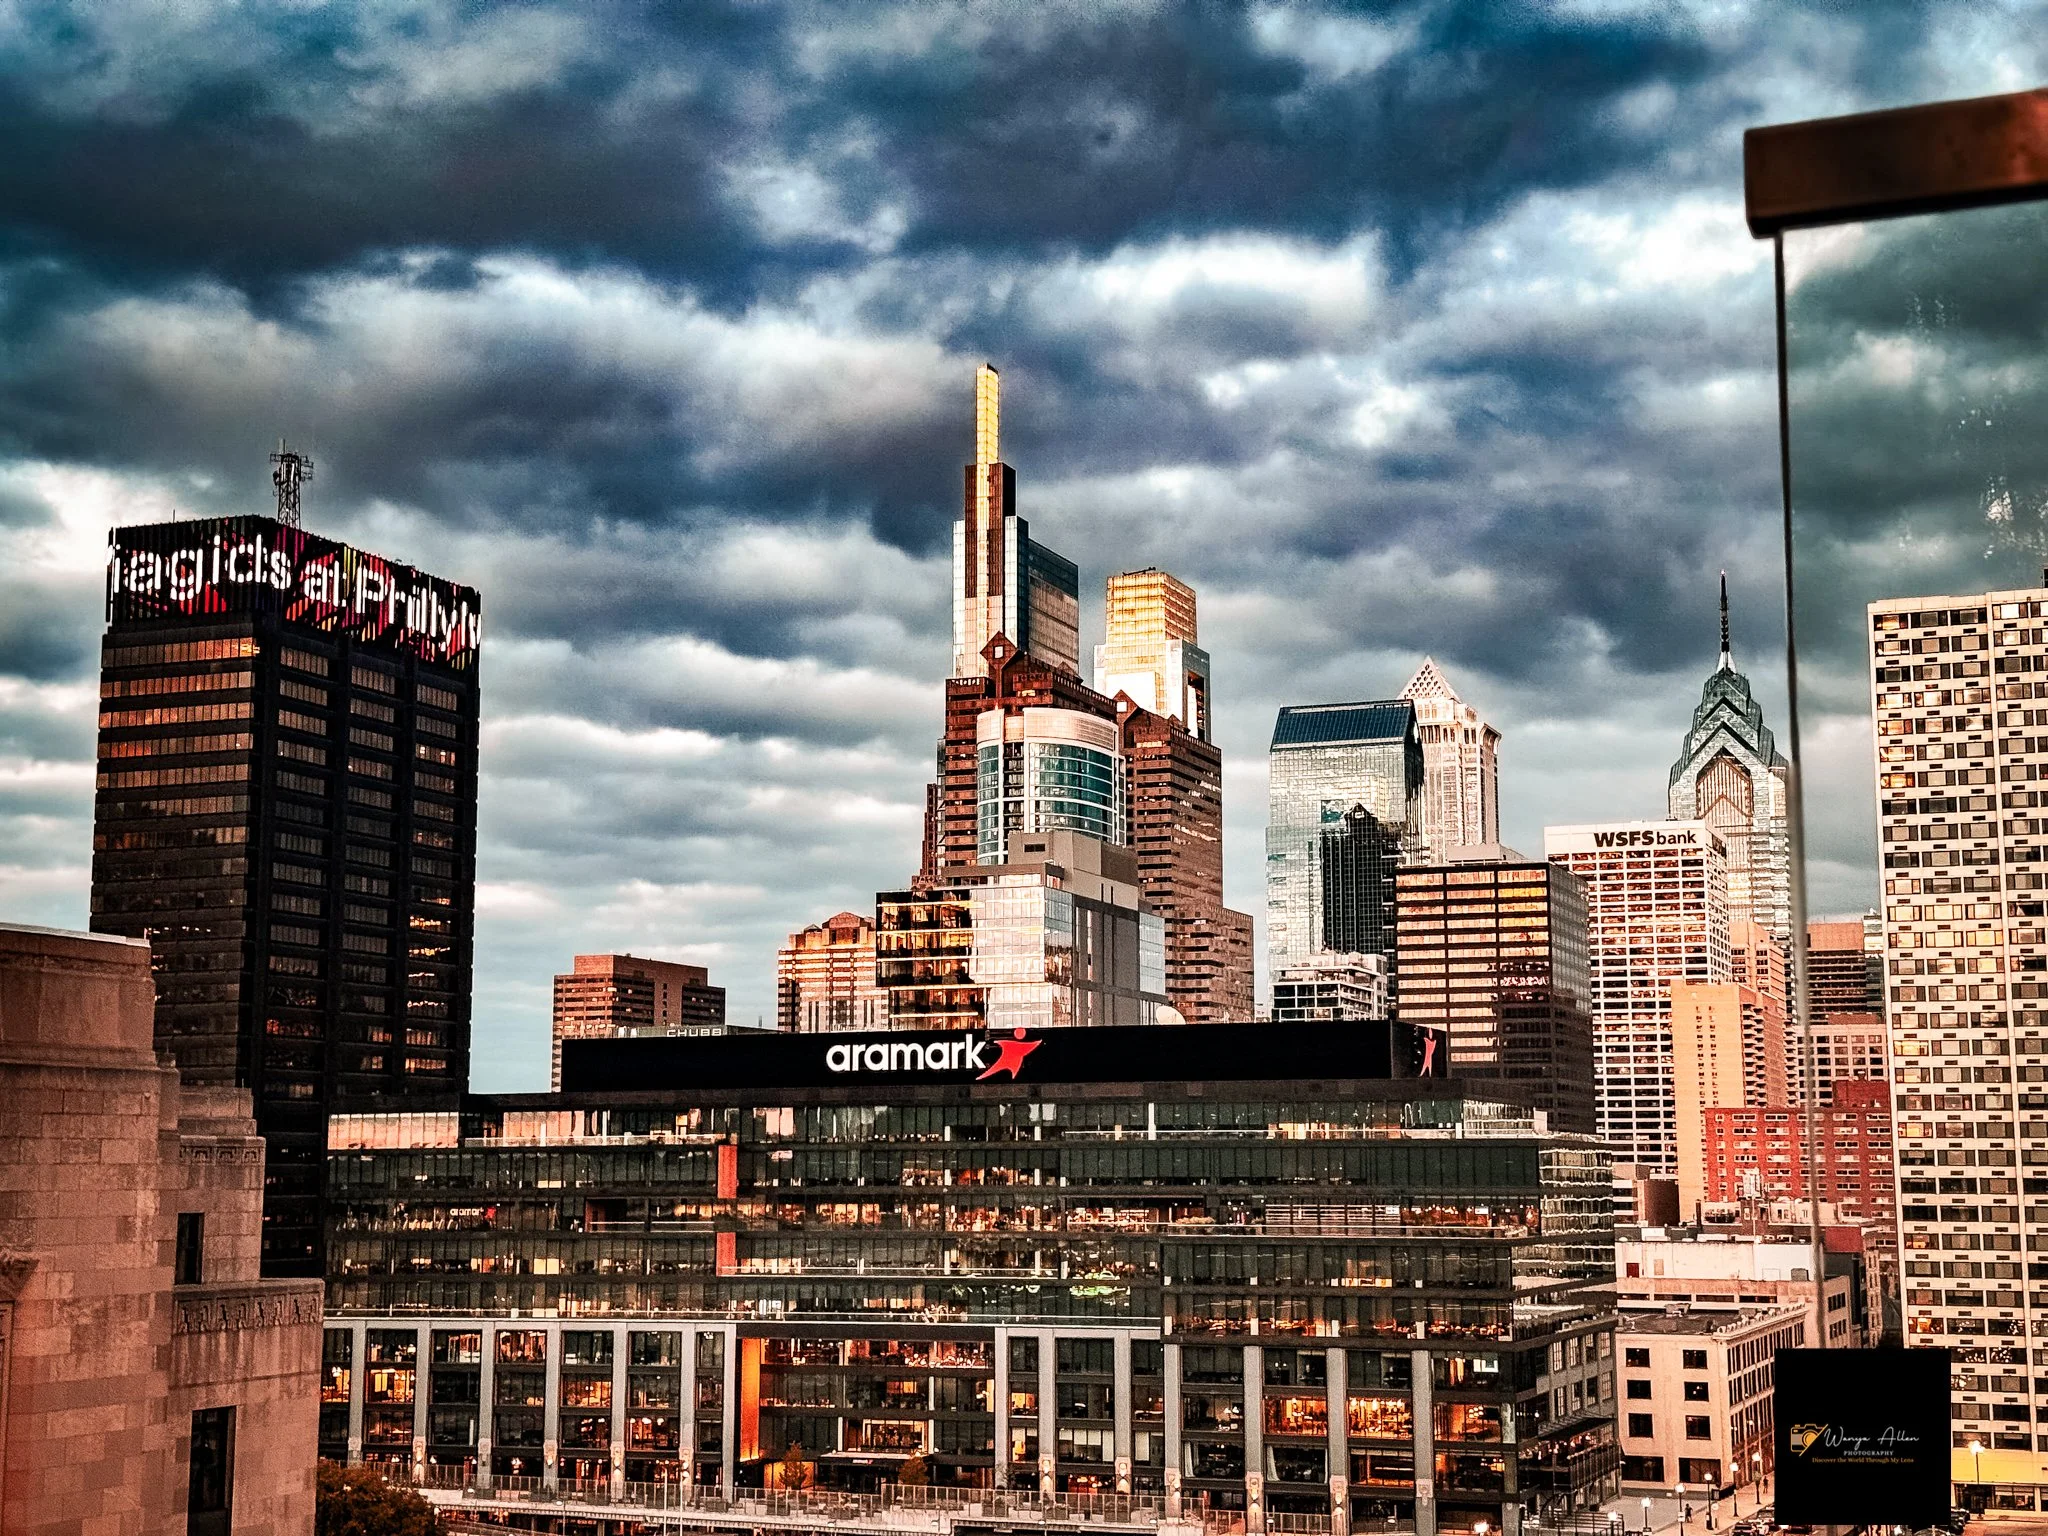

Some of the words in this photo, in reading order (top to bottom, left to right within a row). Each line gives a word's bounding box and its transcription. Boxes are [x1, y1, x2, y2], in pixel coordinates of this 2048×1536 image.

[1593, 830, 1655, 848] WSFS
[1656, 829, 1697, 846] bank
[666, 1028, 722, 1038] CHUBB
[826, 1033, 987, 1072] aramark
